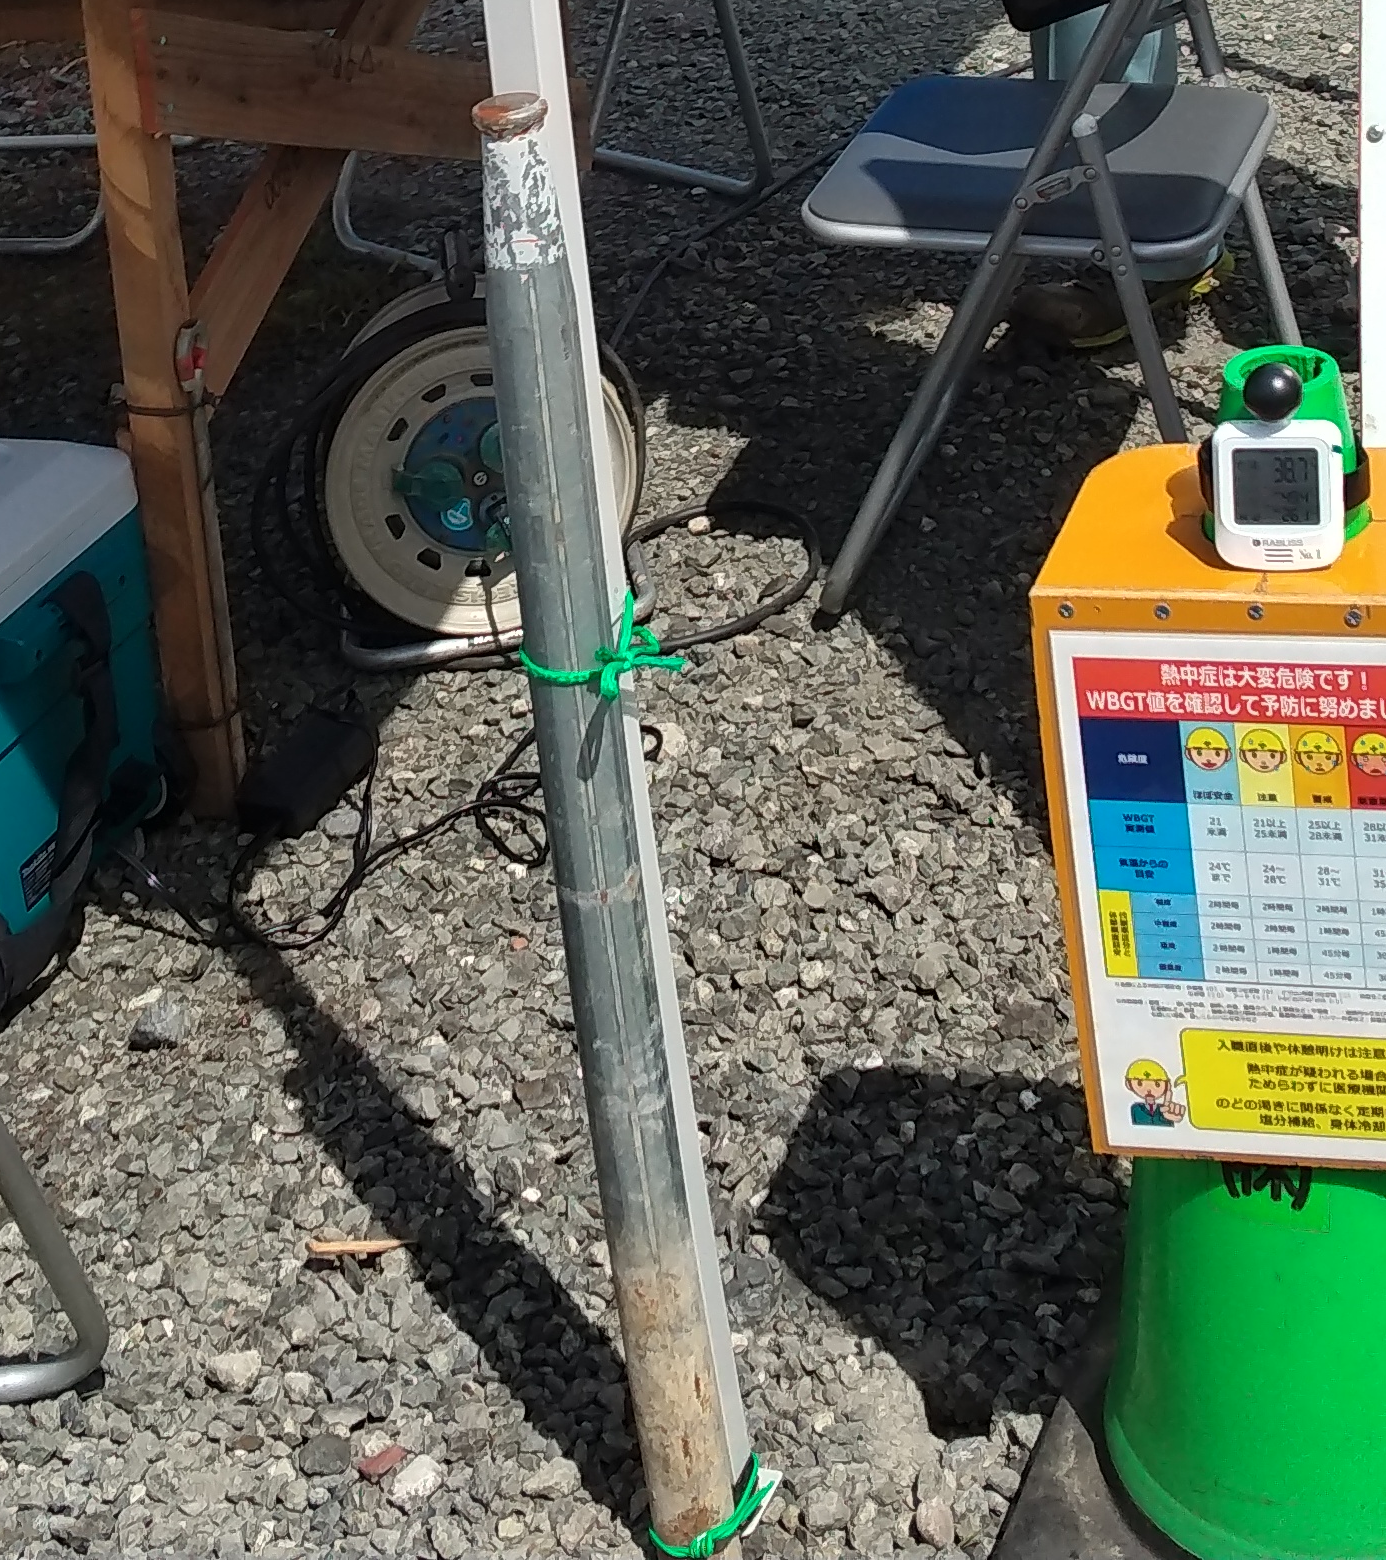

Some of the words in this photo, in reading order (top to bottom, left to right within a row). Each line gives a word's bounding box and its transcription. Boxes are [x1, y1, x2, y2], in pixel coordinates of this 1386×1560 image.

[1160, 663, 1369, 691] 熱中症は大変危険です！
[1123, 813, 1155, 822] WBGT
